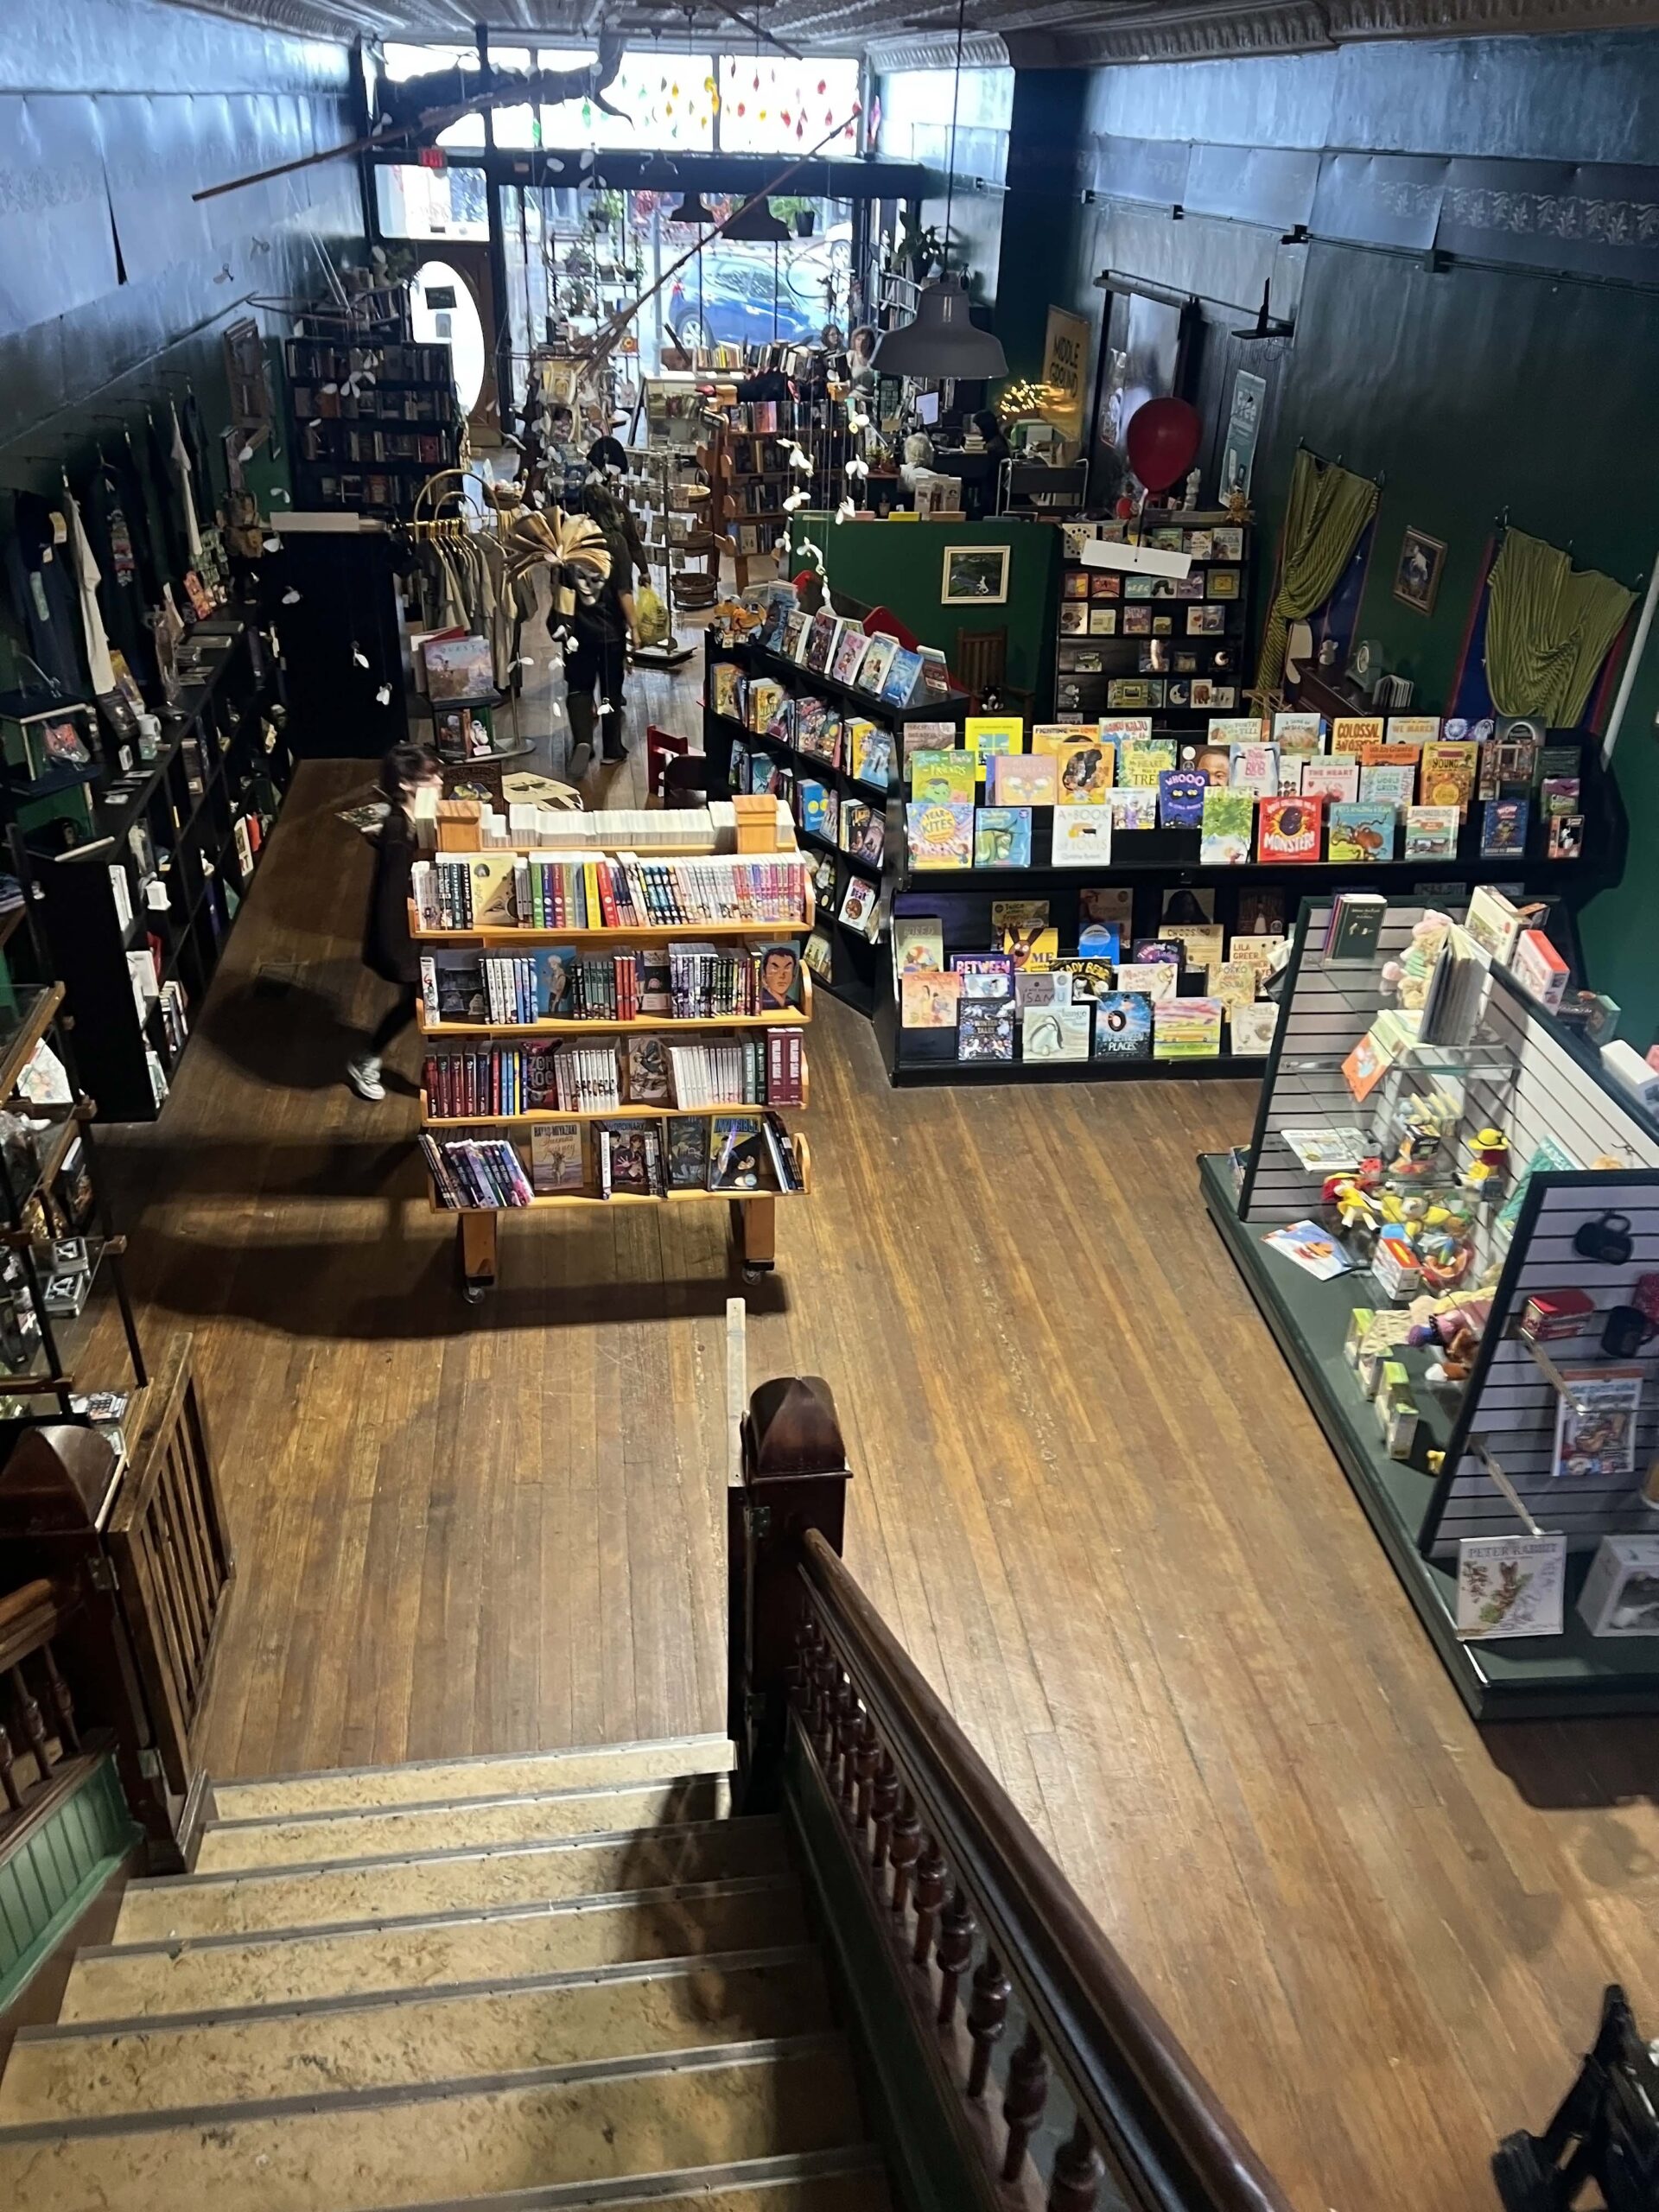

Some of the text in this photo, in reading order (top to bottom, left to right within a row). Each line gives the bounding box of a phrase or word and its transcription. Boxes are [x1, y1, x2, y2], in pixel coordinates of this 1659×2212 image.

[1053, 334, 1080, 369] MIDDLE
[1338, 723, 1379, 738] COLOSSAL
[1133, 774, 1159, 785] TRE
[1166, 774, 1205, 786] WHOOO
[957, 960, 1011, 974] BETWEEN
[1022, 992, 1065, 1002] ISAMU
[552, 1125, 577, 1136] MIYAZAKI
[1469, 1546, 1510, 1557] PETER
